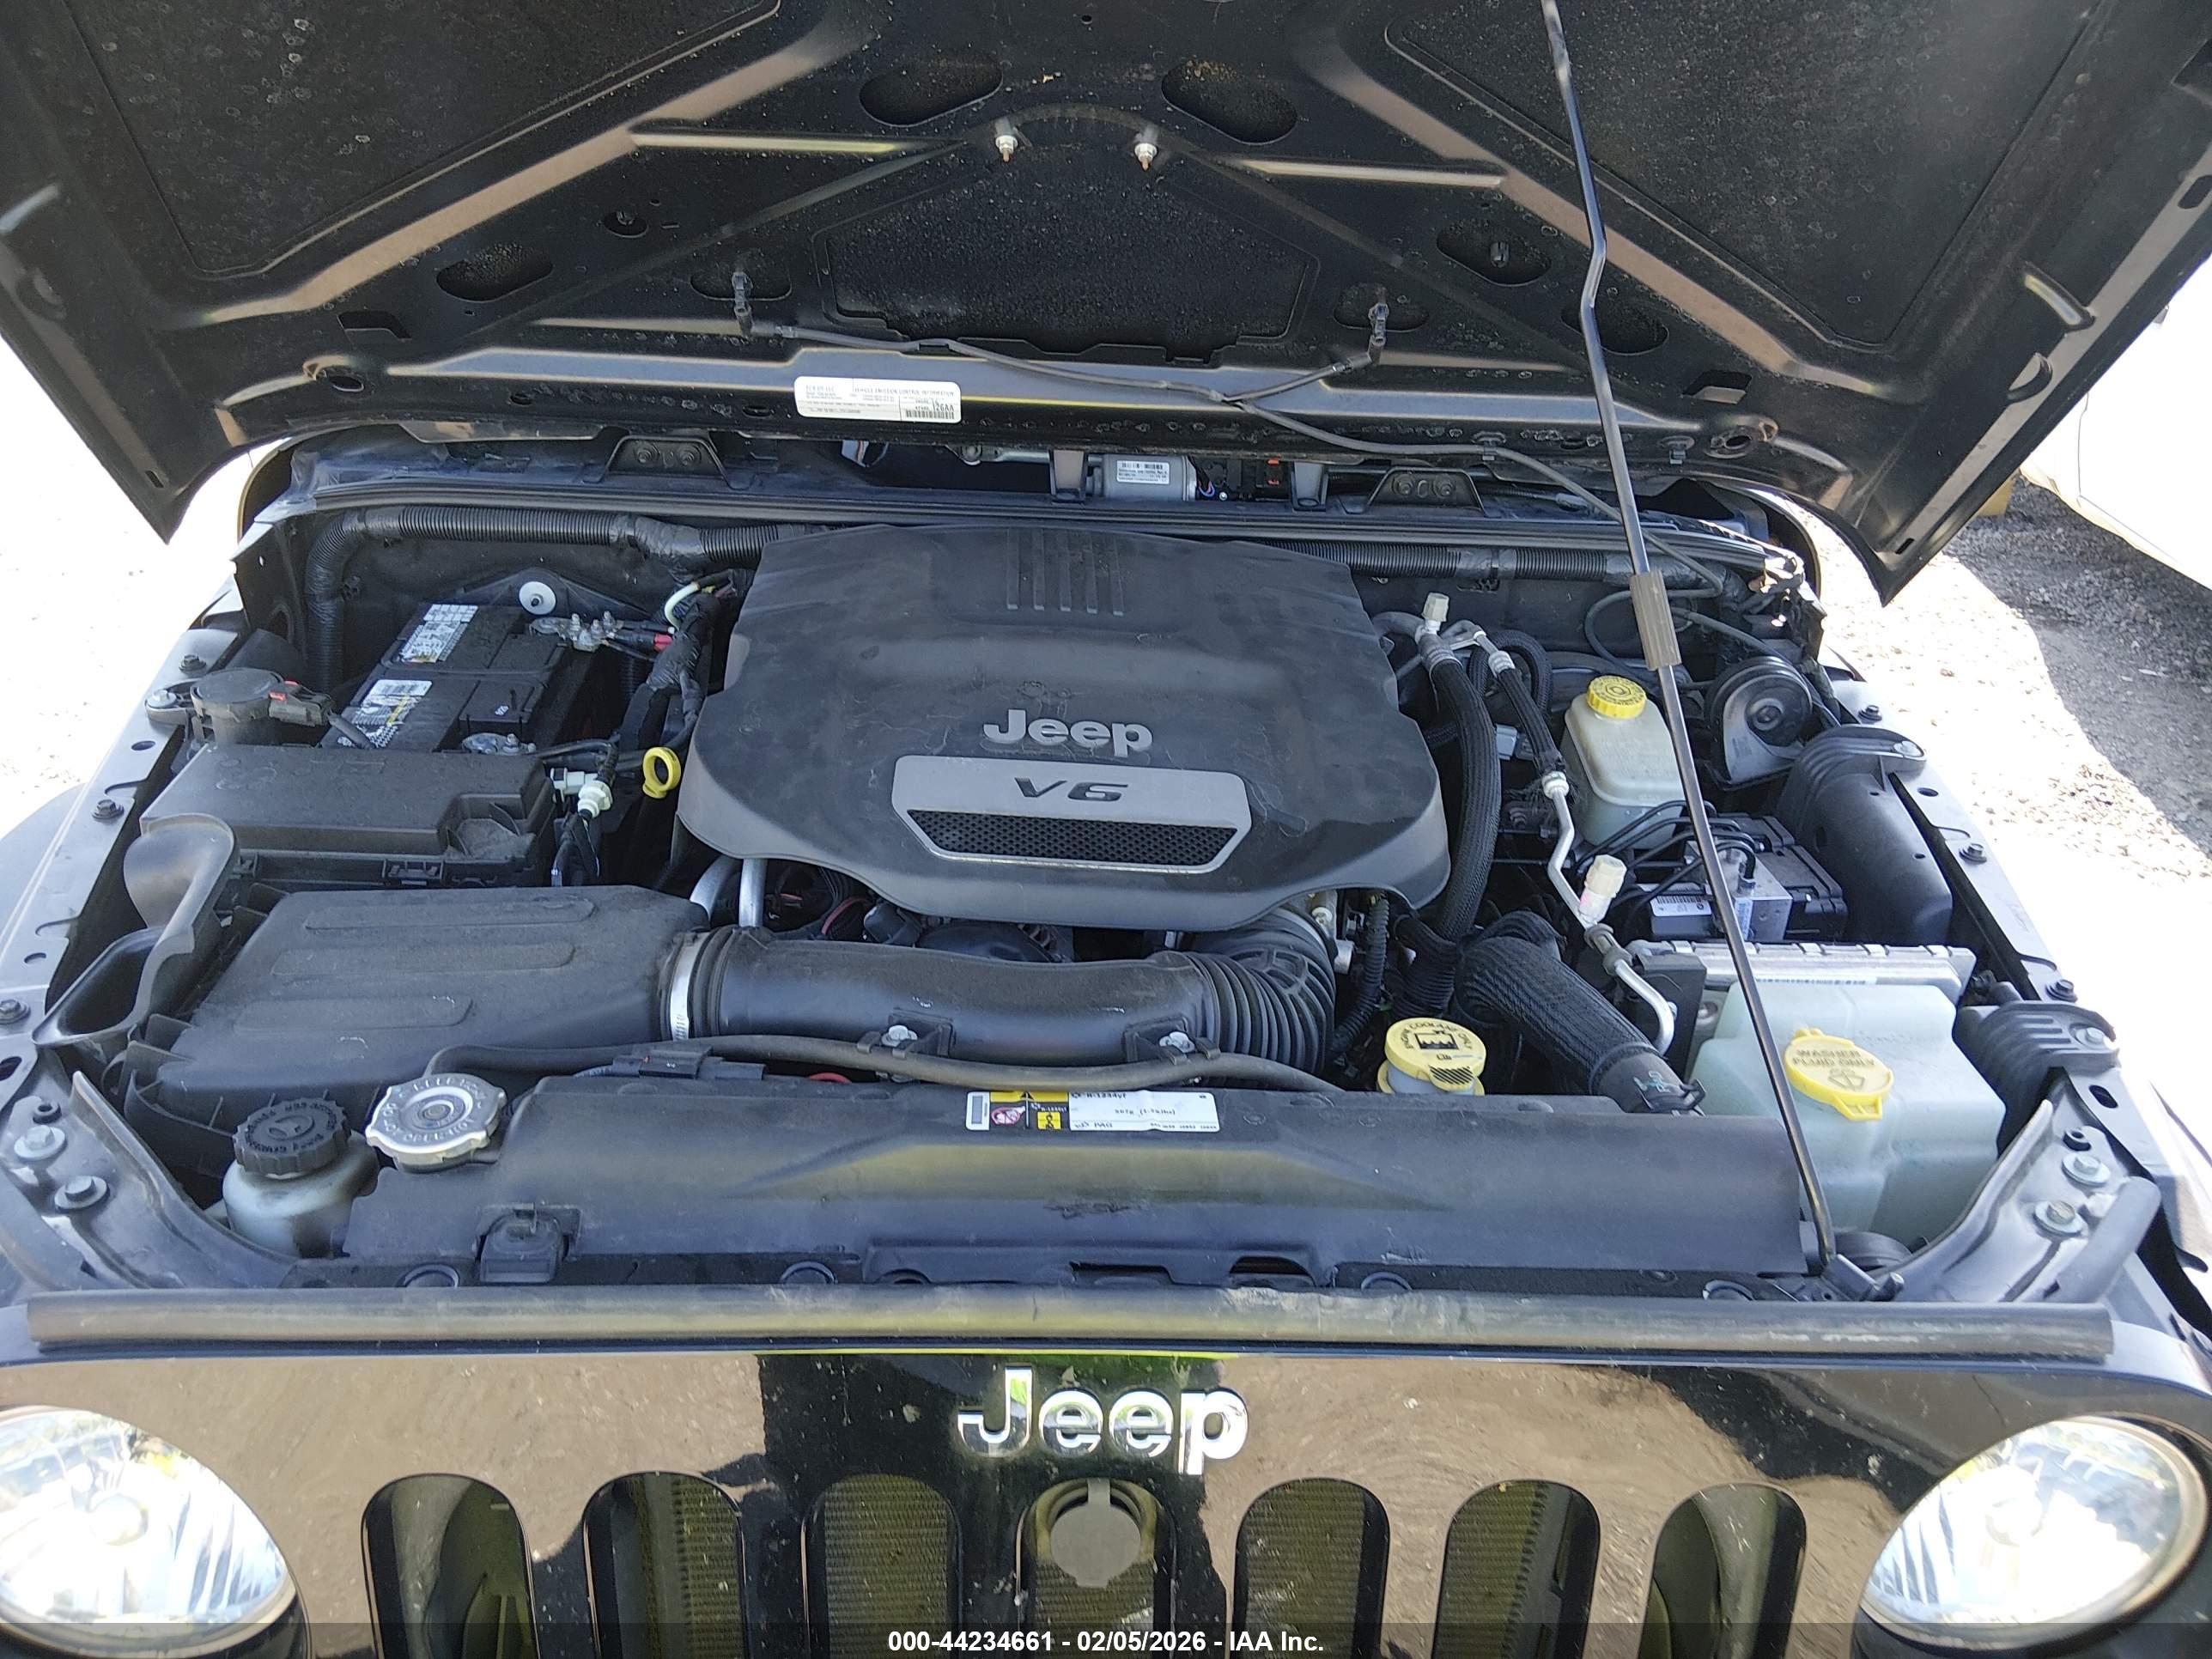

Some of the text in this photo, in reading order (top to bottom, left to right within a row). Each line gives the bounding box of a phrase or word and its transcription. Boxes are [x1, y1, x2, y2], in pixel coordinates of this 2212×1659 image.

[981, 708, 1153, 757] Jeep
[1014, 776, 1128, 802] V6
[1792, 1057, 1875, 1066] FLUID ONLY
[1796, 1048, 1861, 1060] WASHER
[957, 1366, 1249, 1476] Jeep
